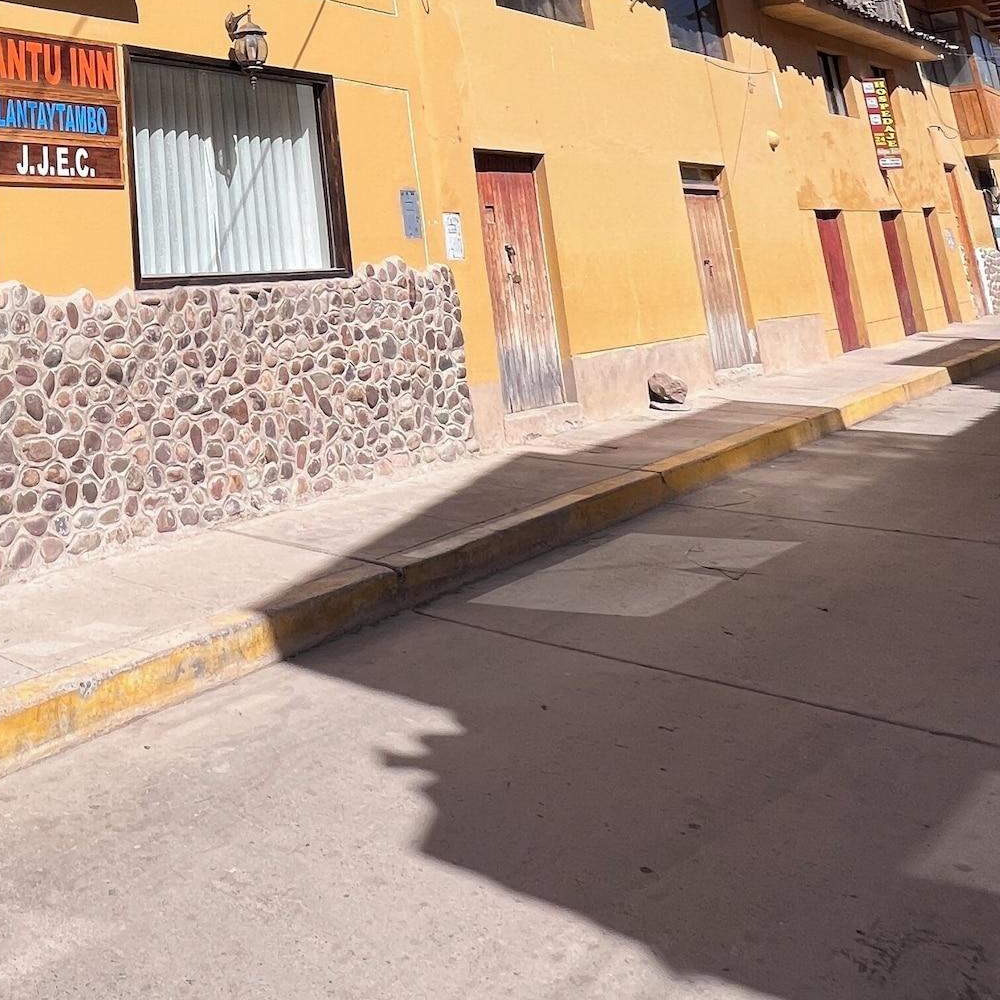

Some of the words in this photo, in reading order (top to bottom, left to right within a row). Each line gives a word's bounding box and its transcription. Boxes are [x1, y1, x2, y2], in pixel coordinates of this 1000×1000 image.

[70, 47, 114, 91] INN
[873, 81, 898, 148] HOSPEDAJE
[16, 144, 96, 178] J.J.E.C.
